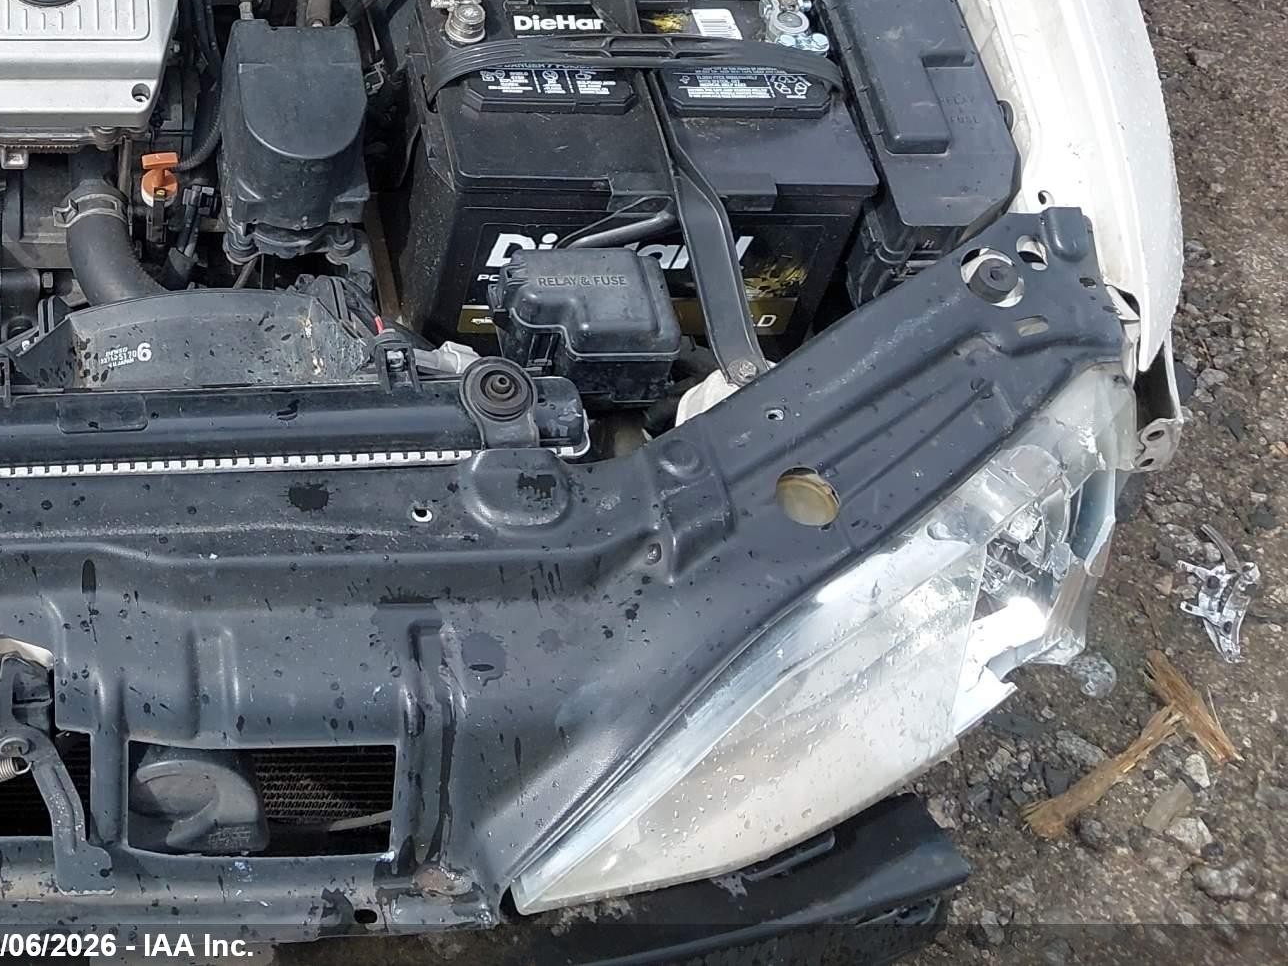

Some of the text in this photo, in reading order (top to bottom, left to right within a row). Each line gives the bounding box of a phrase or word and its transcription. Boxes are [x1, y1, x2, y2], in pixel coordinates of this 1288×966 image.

[513, 14, 605, 31] DieHar
[537, 275, 627, 287] RELAY & FUSE
[137, 342, 152, 361] 6
